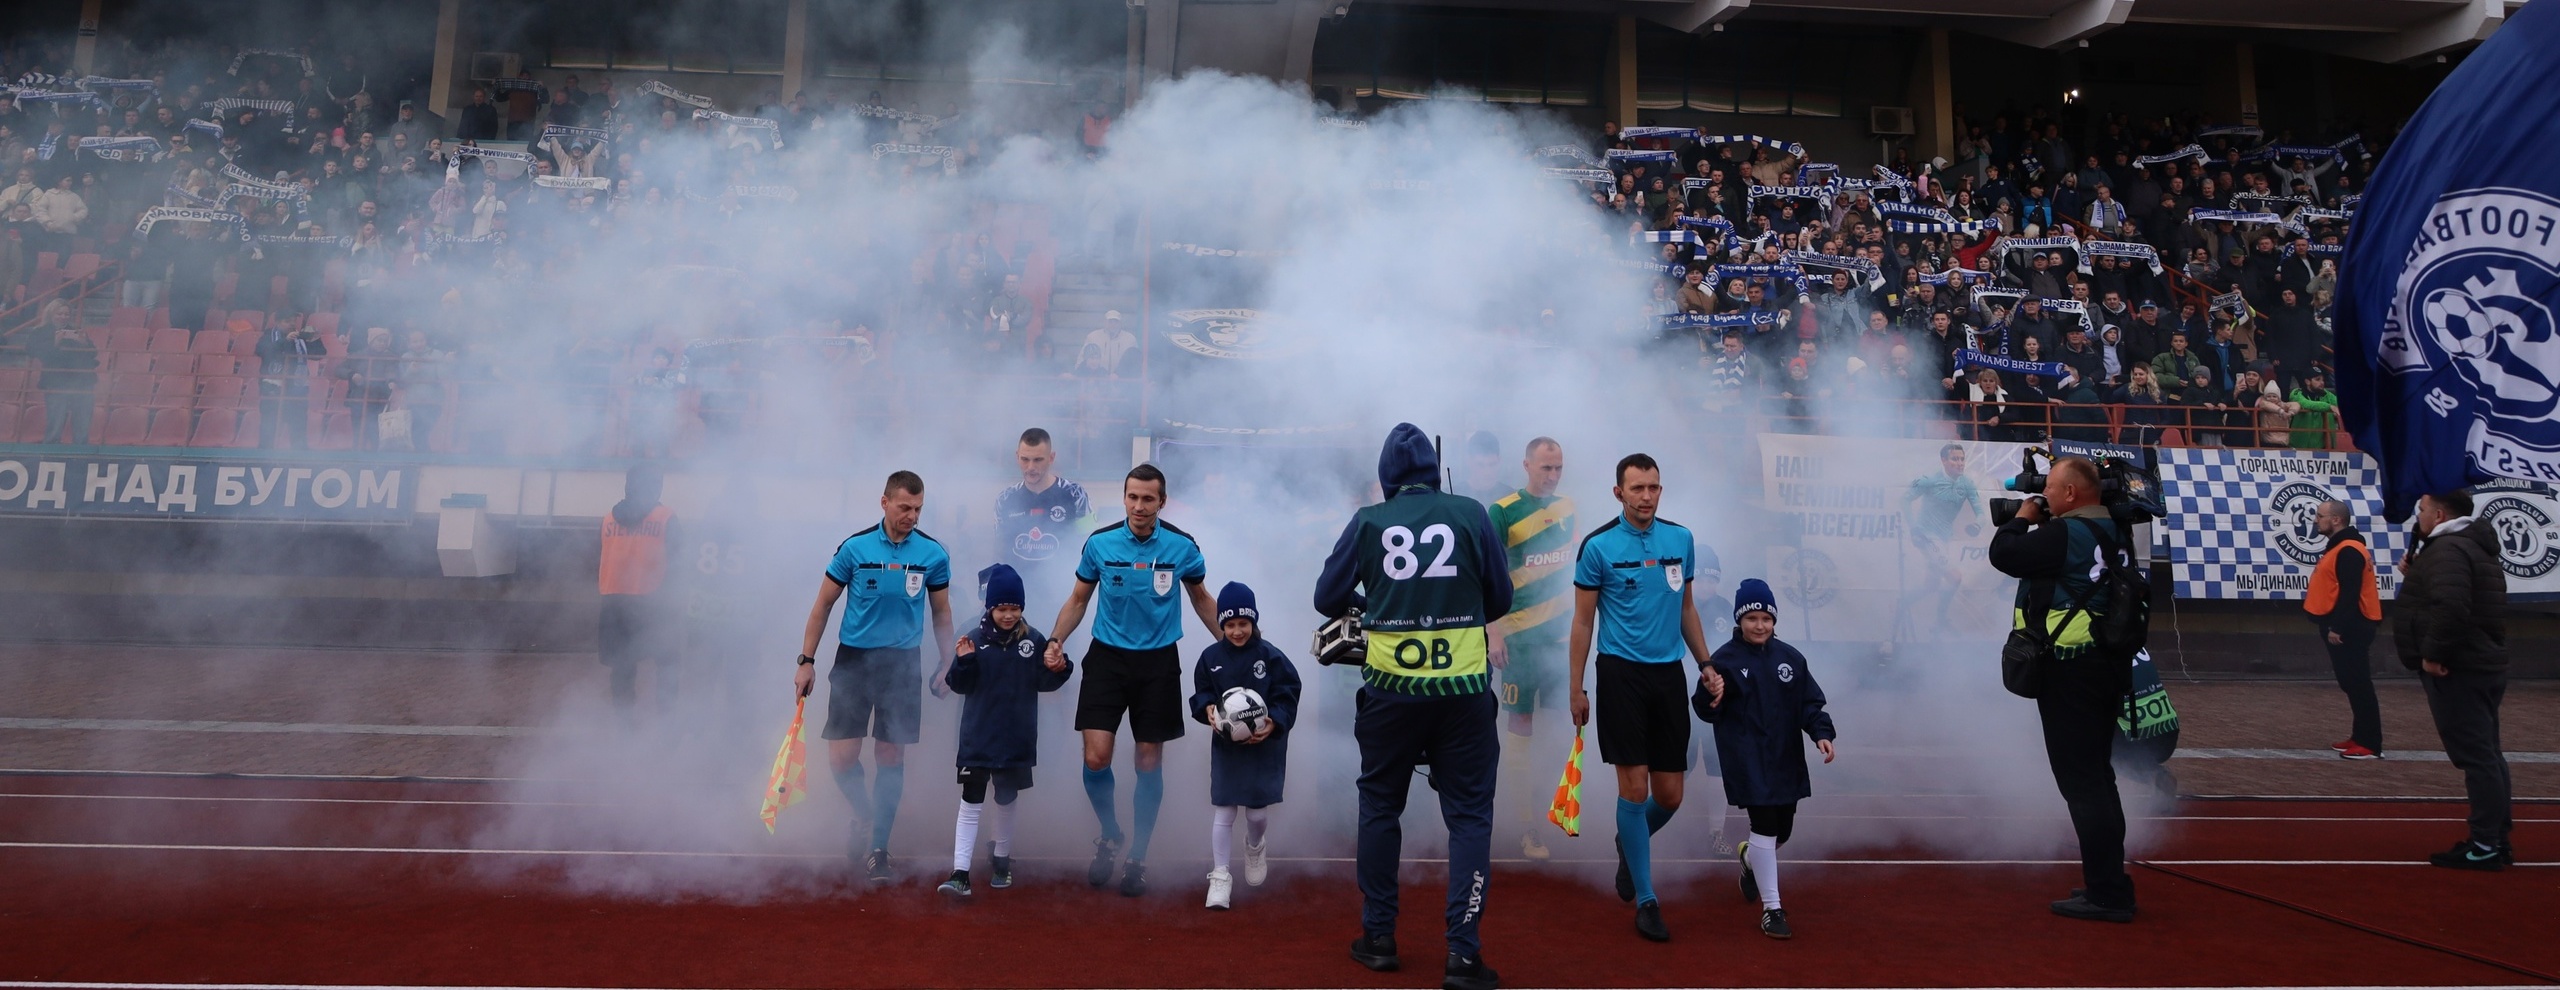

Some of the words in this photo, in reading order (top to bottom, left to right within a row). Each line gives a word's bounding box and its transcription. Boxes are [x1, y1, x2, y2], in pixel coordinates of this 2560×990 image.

[1882, 201, 1935, 217] ДИНАМО
[2010, 237, 2049, 246] DYNAMO
[1643, 262, 1670, 273] BREST
[1966, 352, 2010, 368] DYNAMO
[2011, 360, 2046, 372] BREST
[2060, 445, 2089, 456] НАША
[2240, 458, 2279, 476] ГОРАД
[2281, 459, 2306, 477] НАД
[2307, 459, 2349, 476] БУГАМ
[83, 462, 198, 512] НАД
[213, 466, 401, 509] БУГОМ
[1778, 483, 1886, 509] ЧЕМПИОН
[2275, 485, 2312, 509] FOOTBALL
[2521, 503, 2546, 522] CLUB
[604, 521, 661, 538] STEWARD
[2271, 518, 2281, 527] 19
[2545, 531, 2559, 541] 60
[1381, 523, 1458, 581] 82
[1524, 551, 1573, 567] FONBET
[2279, 538, 2318, 563] DYNAMO
[2533, 551, 2558, 575] BREST
[2236, 575, 2259, 590] МЫ
[2260, 575, 2309, 591] ДИНАМО
[1237, 707, 1264, 720] uhlsport
